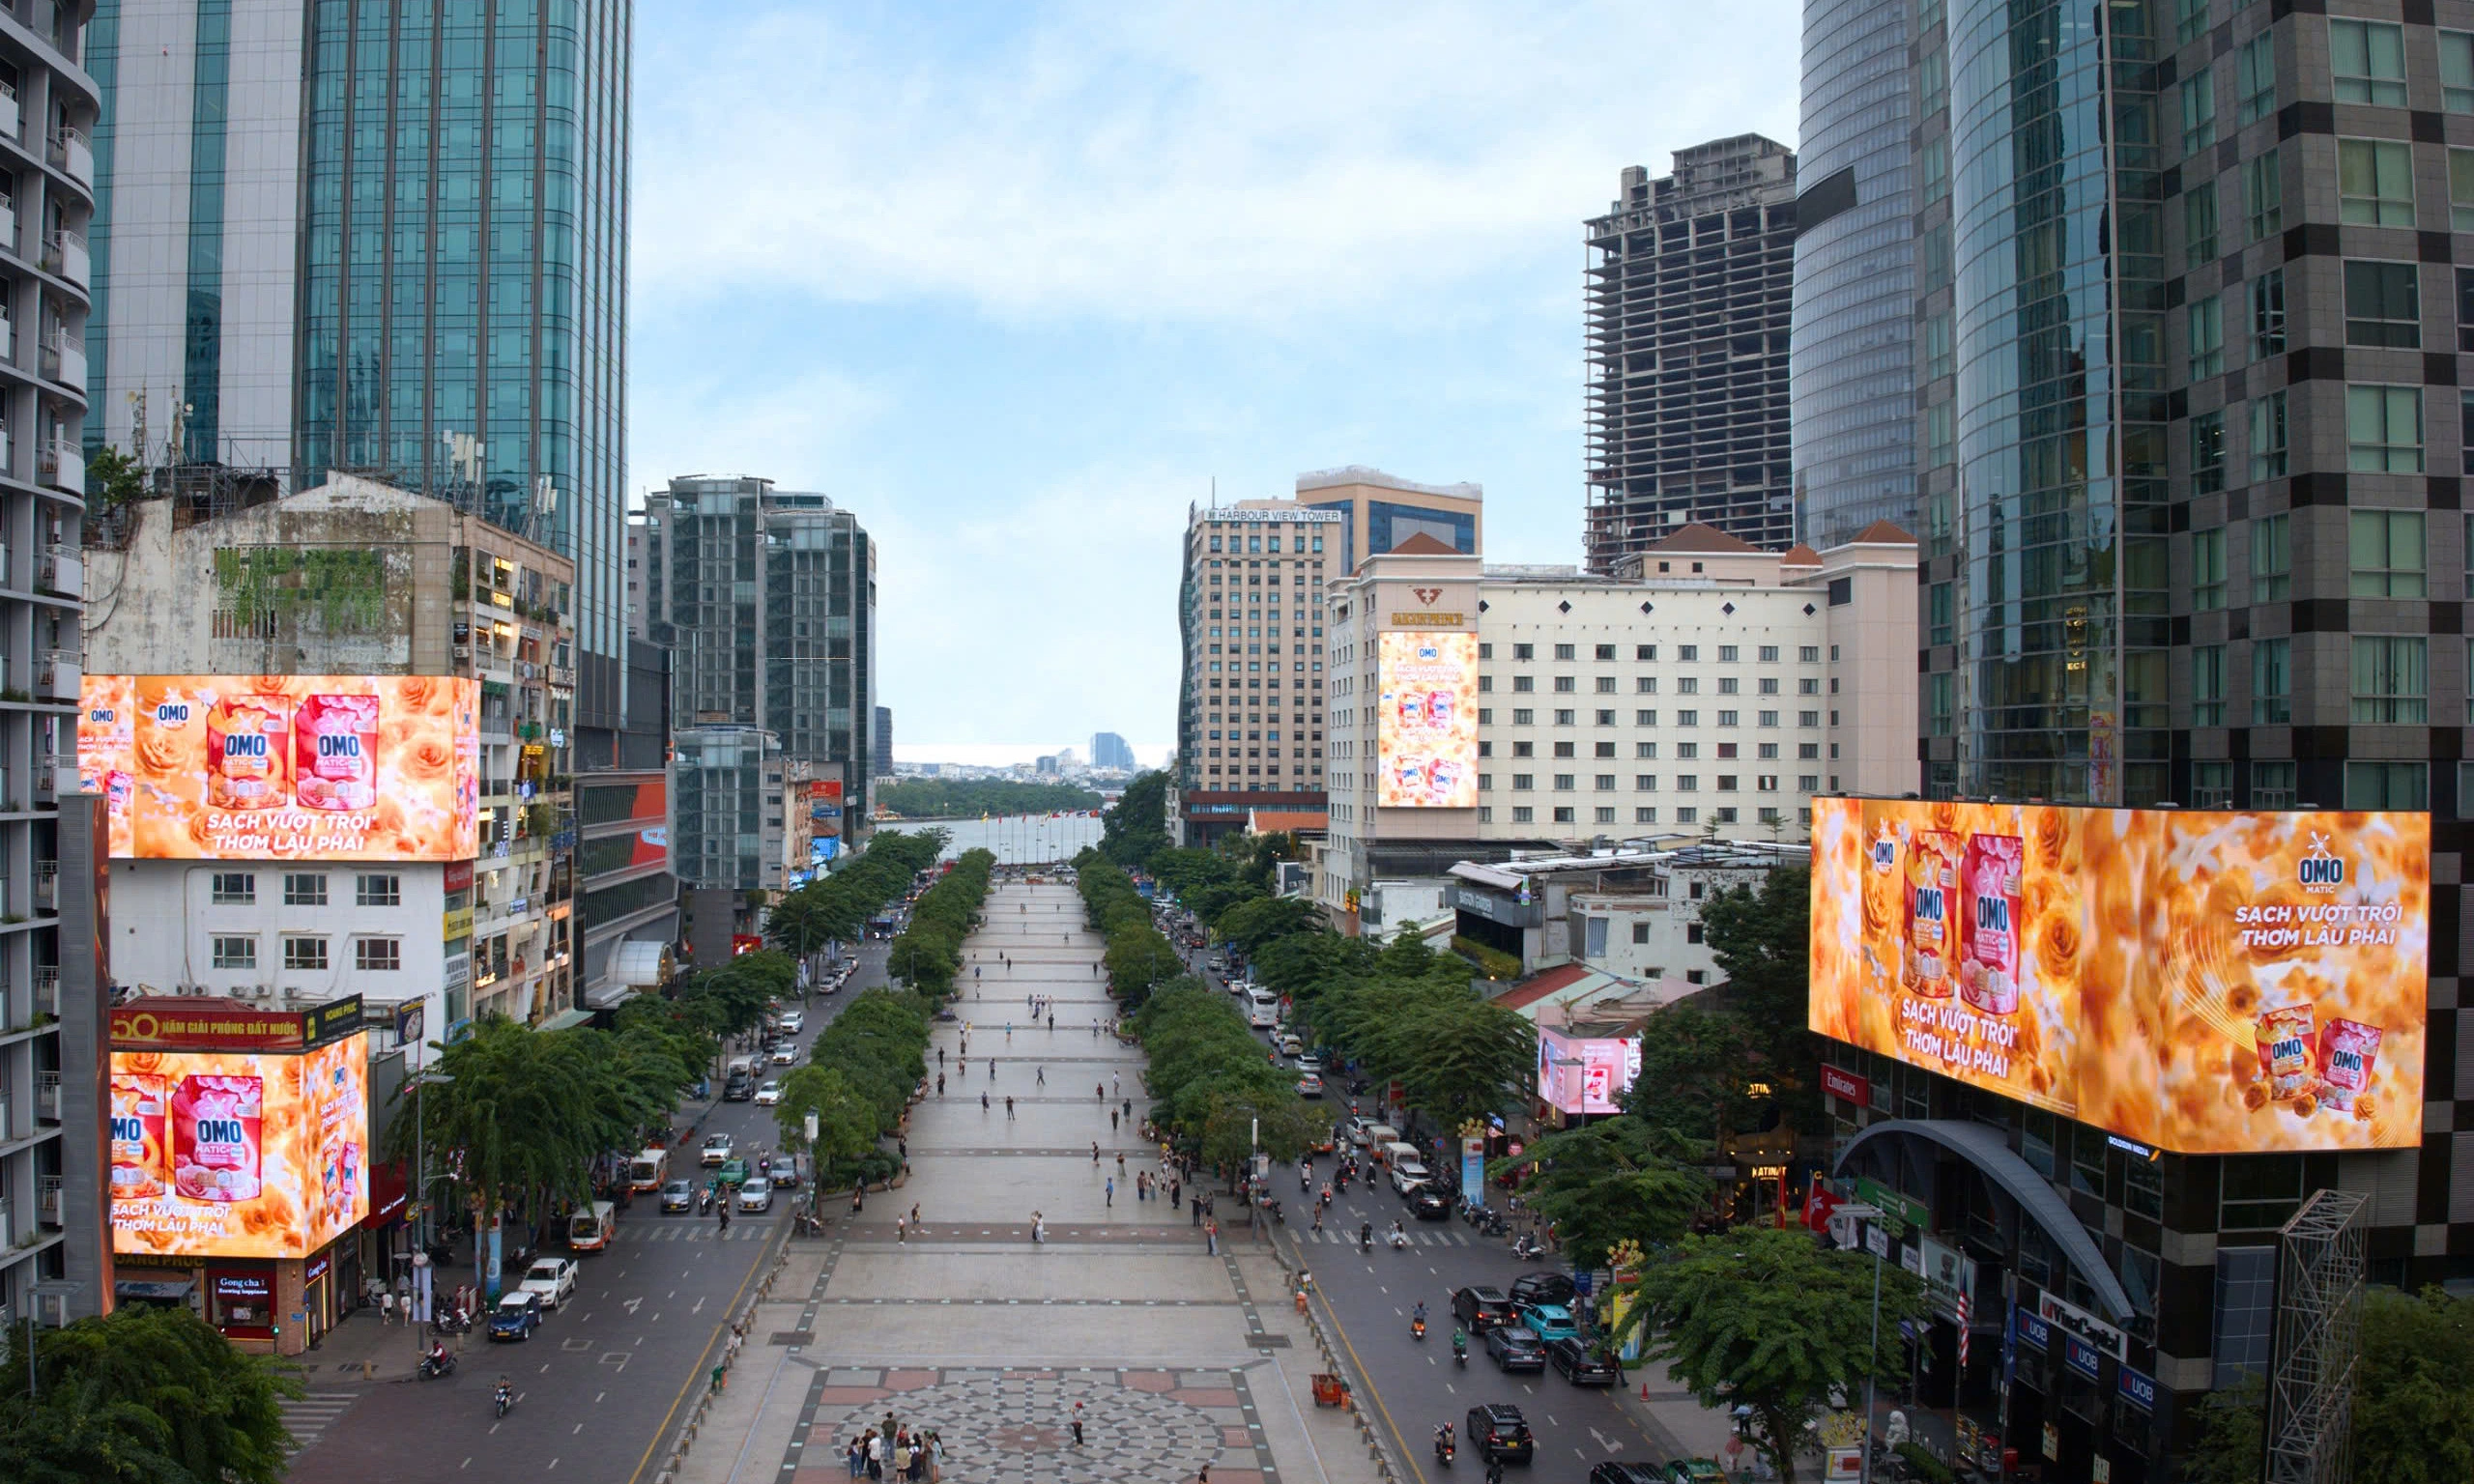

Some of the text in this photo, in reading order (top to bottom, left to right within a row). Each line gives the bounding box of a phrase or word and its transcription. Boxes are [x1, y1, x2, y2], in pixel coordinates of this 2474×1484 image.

[1219, 511, 1339, 521] HARBOUR VIEW TOWER
[1419, 648, 1437, 658] OMO
[91, 710, 113, 722] OMO
[158, 703, 188, 722] OMO
[225, 735, 267, 756] OMO
[319, 735, 360, 756] OMO
[1402, 768, 1418, 778] OMO
[1435, 774, 1451, 785] OMO
[208, 813, 260, 833] SẠCH
[267, 813, 320, 833] VƯỢT
[215, 832, 364, 850] THƠM LÂU PHAI
[1876, 842, 1894, 866] OMO
[2300, 858, 2343, 884] OMO
[2306, 886, 2335, 895] MATIC
[1915, 887, 1942, 921] OMO
[1977, 896, 2008, 933] OMO
[2234, 901, 2403, 927] SẠCH VƯỢT TRỘI
[2242, 925, 2395, 946] THƠM LÂU PHAI
[162, 1019, 186, 1034] NĂM
[187, 1018, 208, 1034] GIẢI
[210, 1018, 245, 1035] PHÓNG
[247, 1019, 268, 1035] ĐẤT
[270, 1020, 298, 1036] NƯỚC
[1902, 997, 1935, 1026] SẠCH
[1940, 1005, 1977, 1037] VƯỢT
[1906, 1028, 2009, 1079] THƠM LÂU PHAI
[2272, 1039, 2302, 1060] OMO
[2333, 1050, 2362, 1071] OMO
[1827, 1071, 1856, 1098] Emirates
[110, 1118, 141, 1141] MO
[198, 1120, 242, 1143] OMO
[113, 1217, 224, 1234] THƠM LÂU PHAI
[219, 1277, 260, 1289] Gong cha
[2029, 1321, 2048, 1341] UOB
[2079, 1349, 2098, 1370] UOB
[2132, 1380, 2154, 1402] UOB
